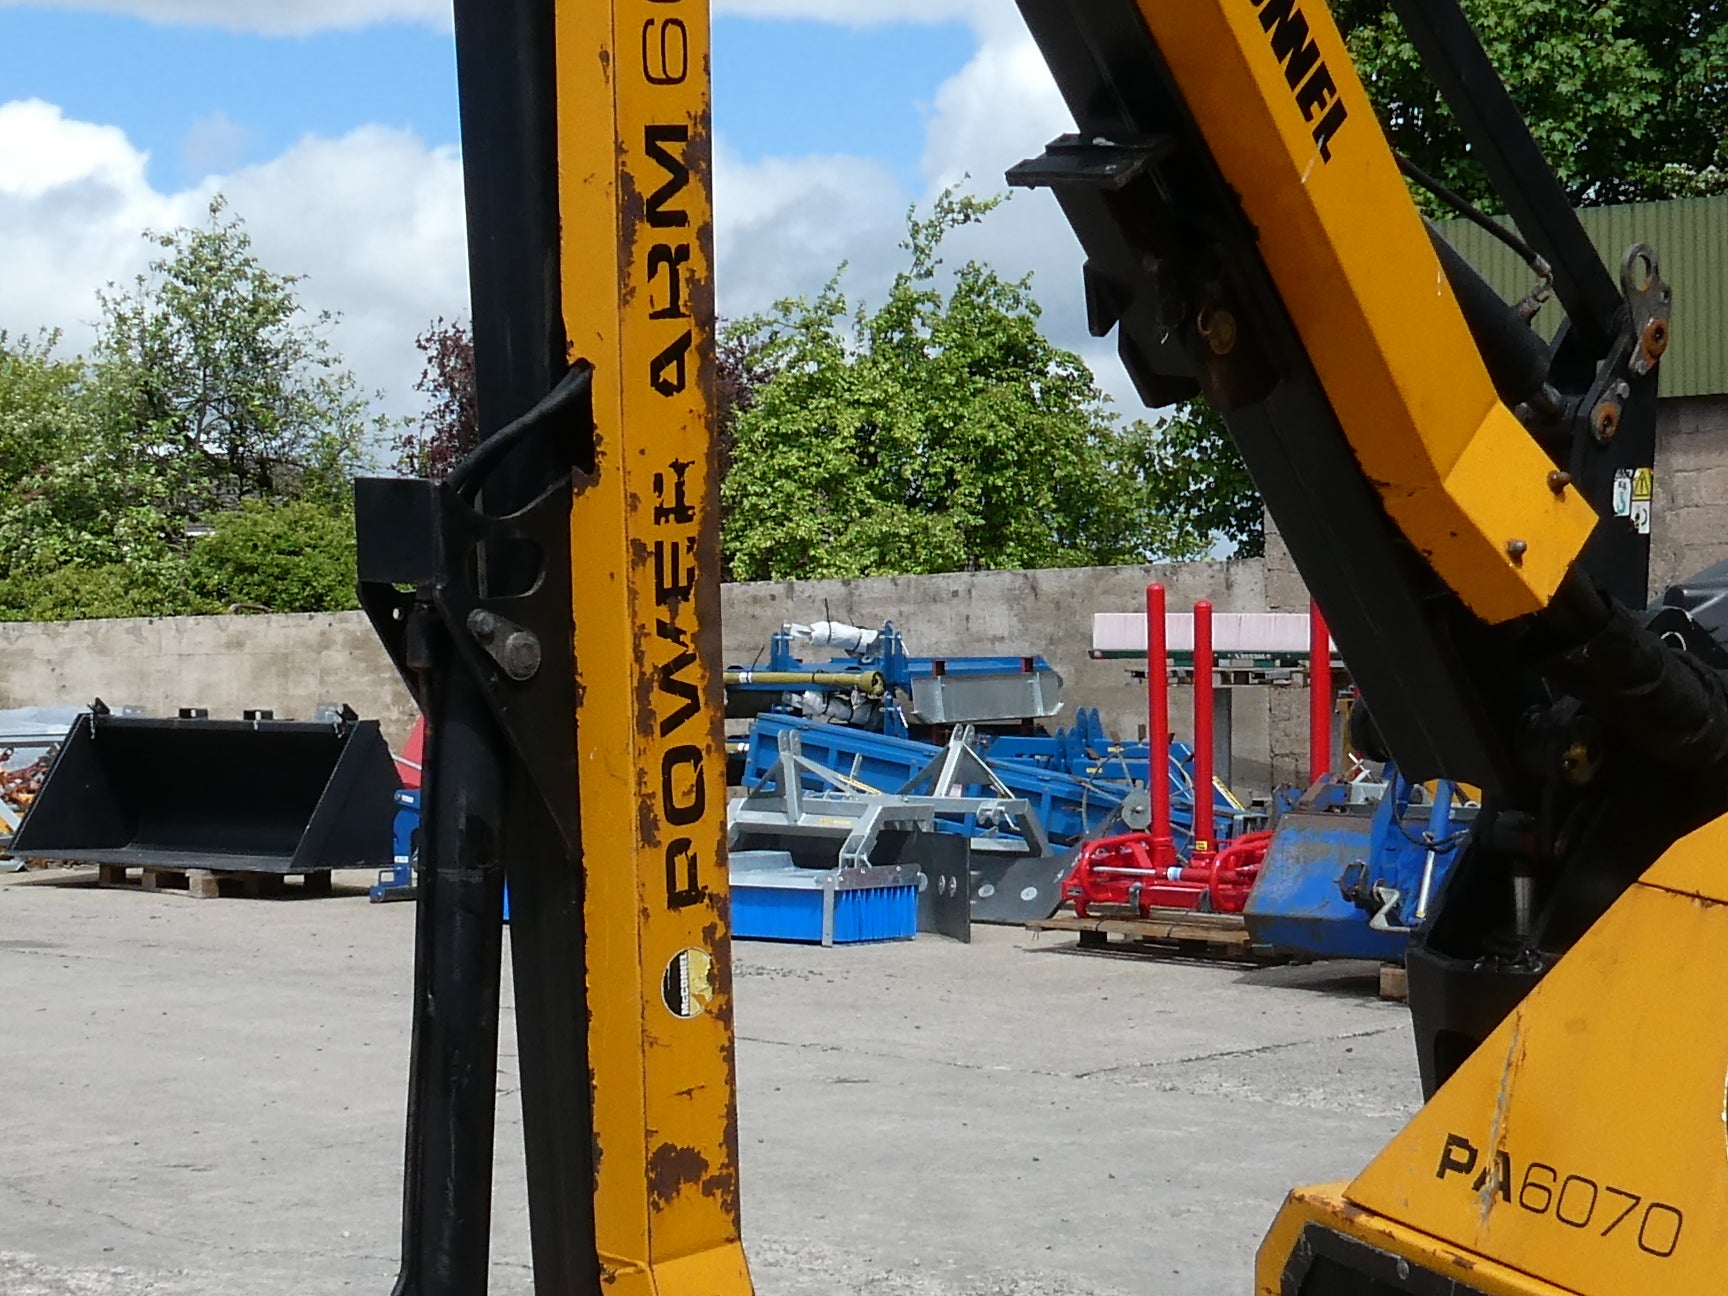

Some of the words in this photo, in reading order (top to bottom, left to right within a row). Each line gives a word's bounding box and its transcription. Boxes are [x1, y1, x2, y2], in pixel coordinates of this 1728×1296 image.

[644, 124, 693, 398] ARM
[651, 456, 709, 910] POWER
[1435, 1132, 1684, 1258] PA6070
